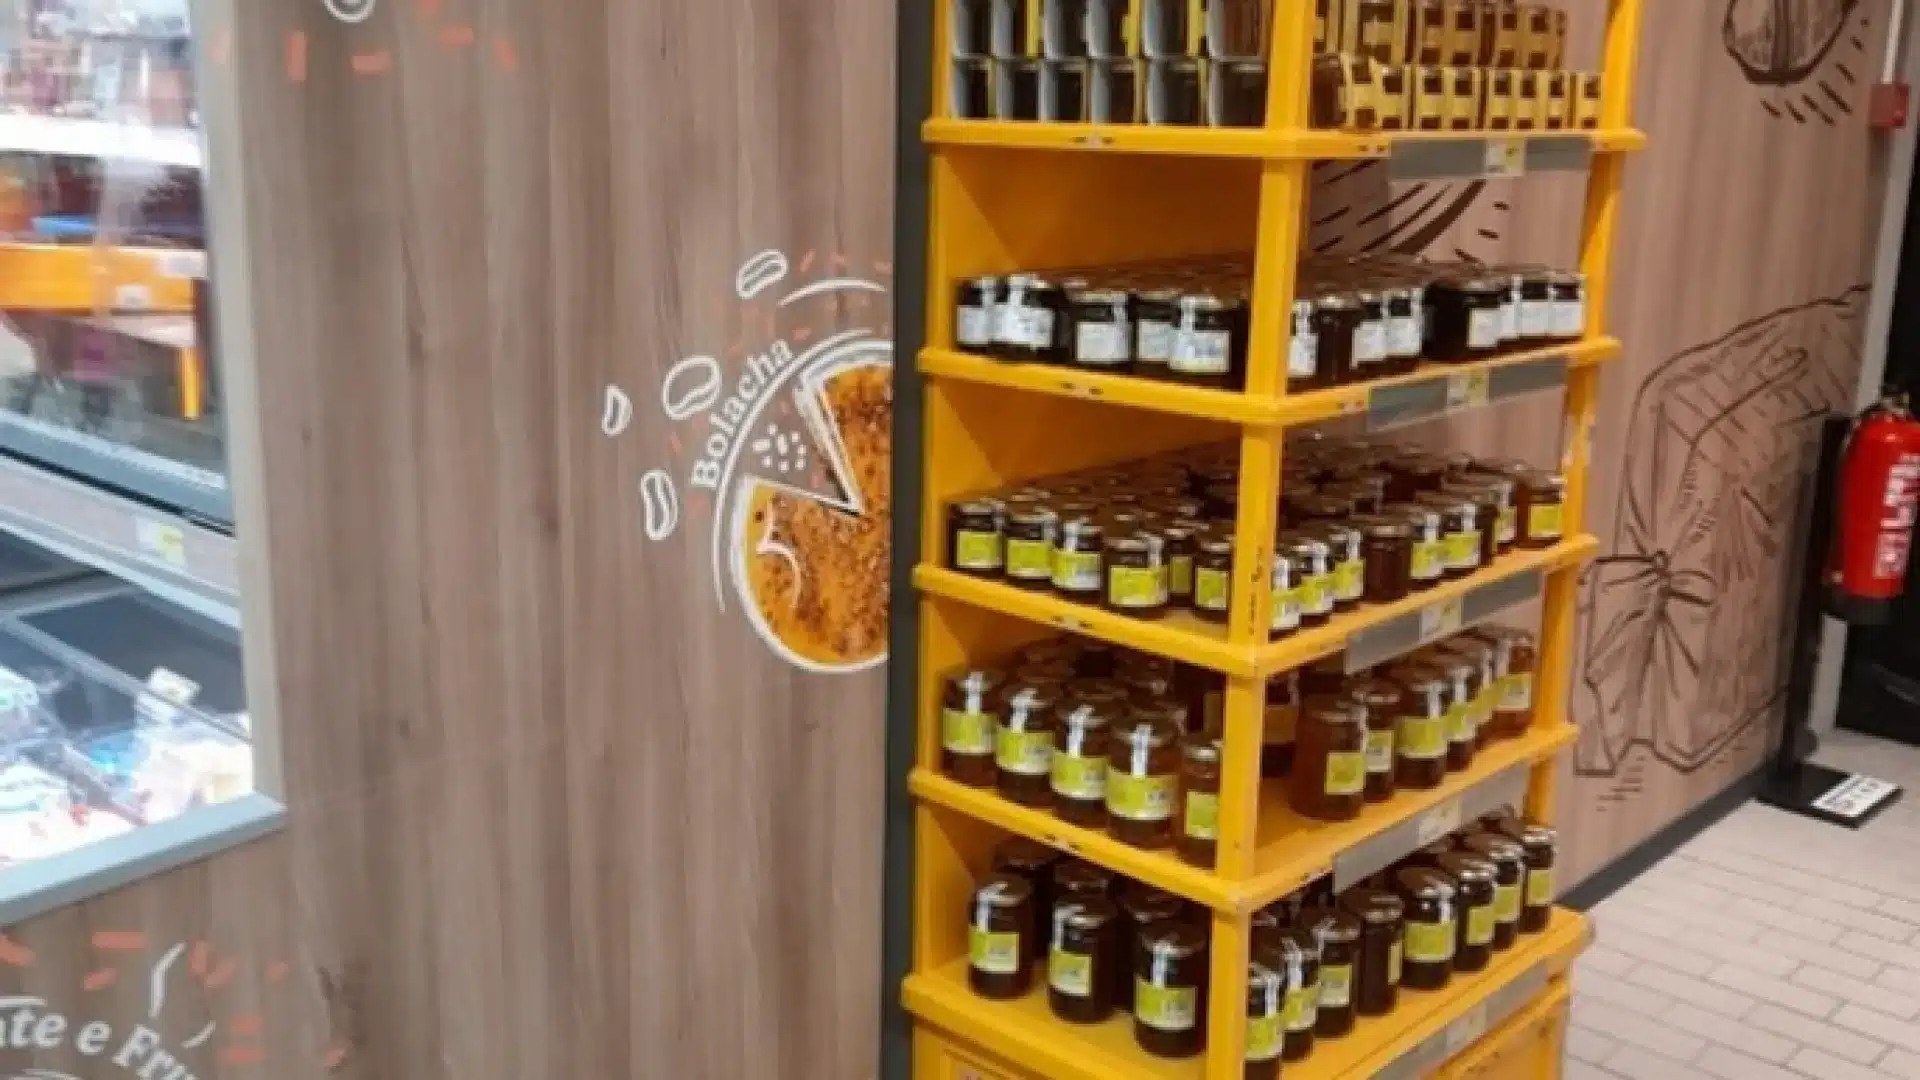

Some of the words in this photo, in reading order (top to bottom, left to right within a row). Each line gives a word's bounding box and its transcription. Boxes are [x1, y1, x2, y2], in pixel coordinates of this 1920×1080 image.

[691, 339, 793, 487] Bolacha
[0, 1009, 67, 1049] te
[76, 1020, 112, 1055] e
